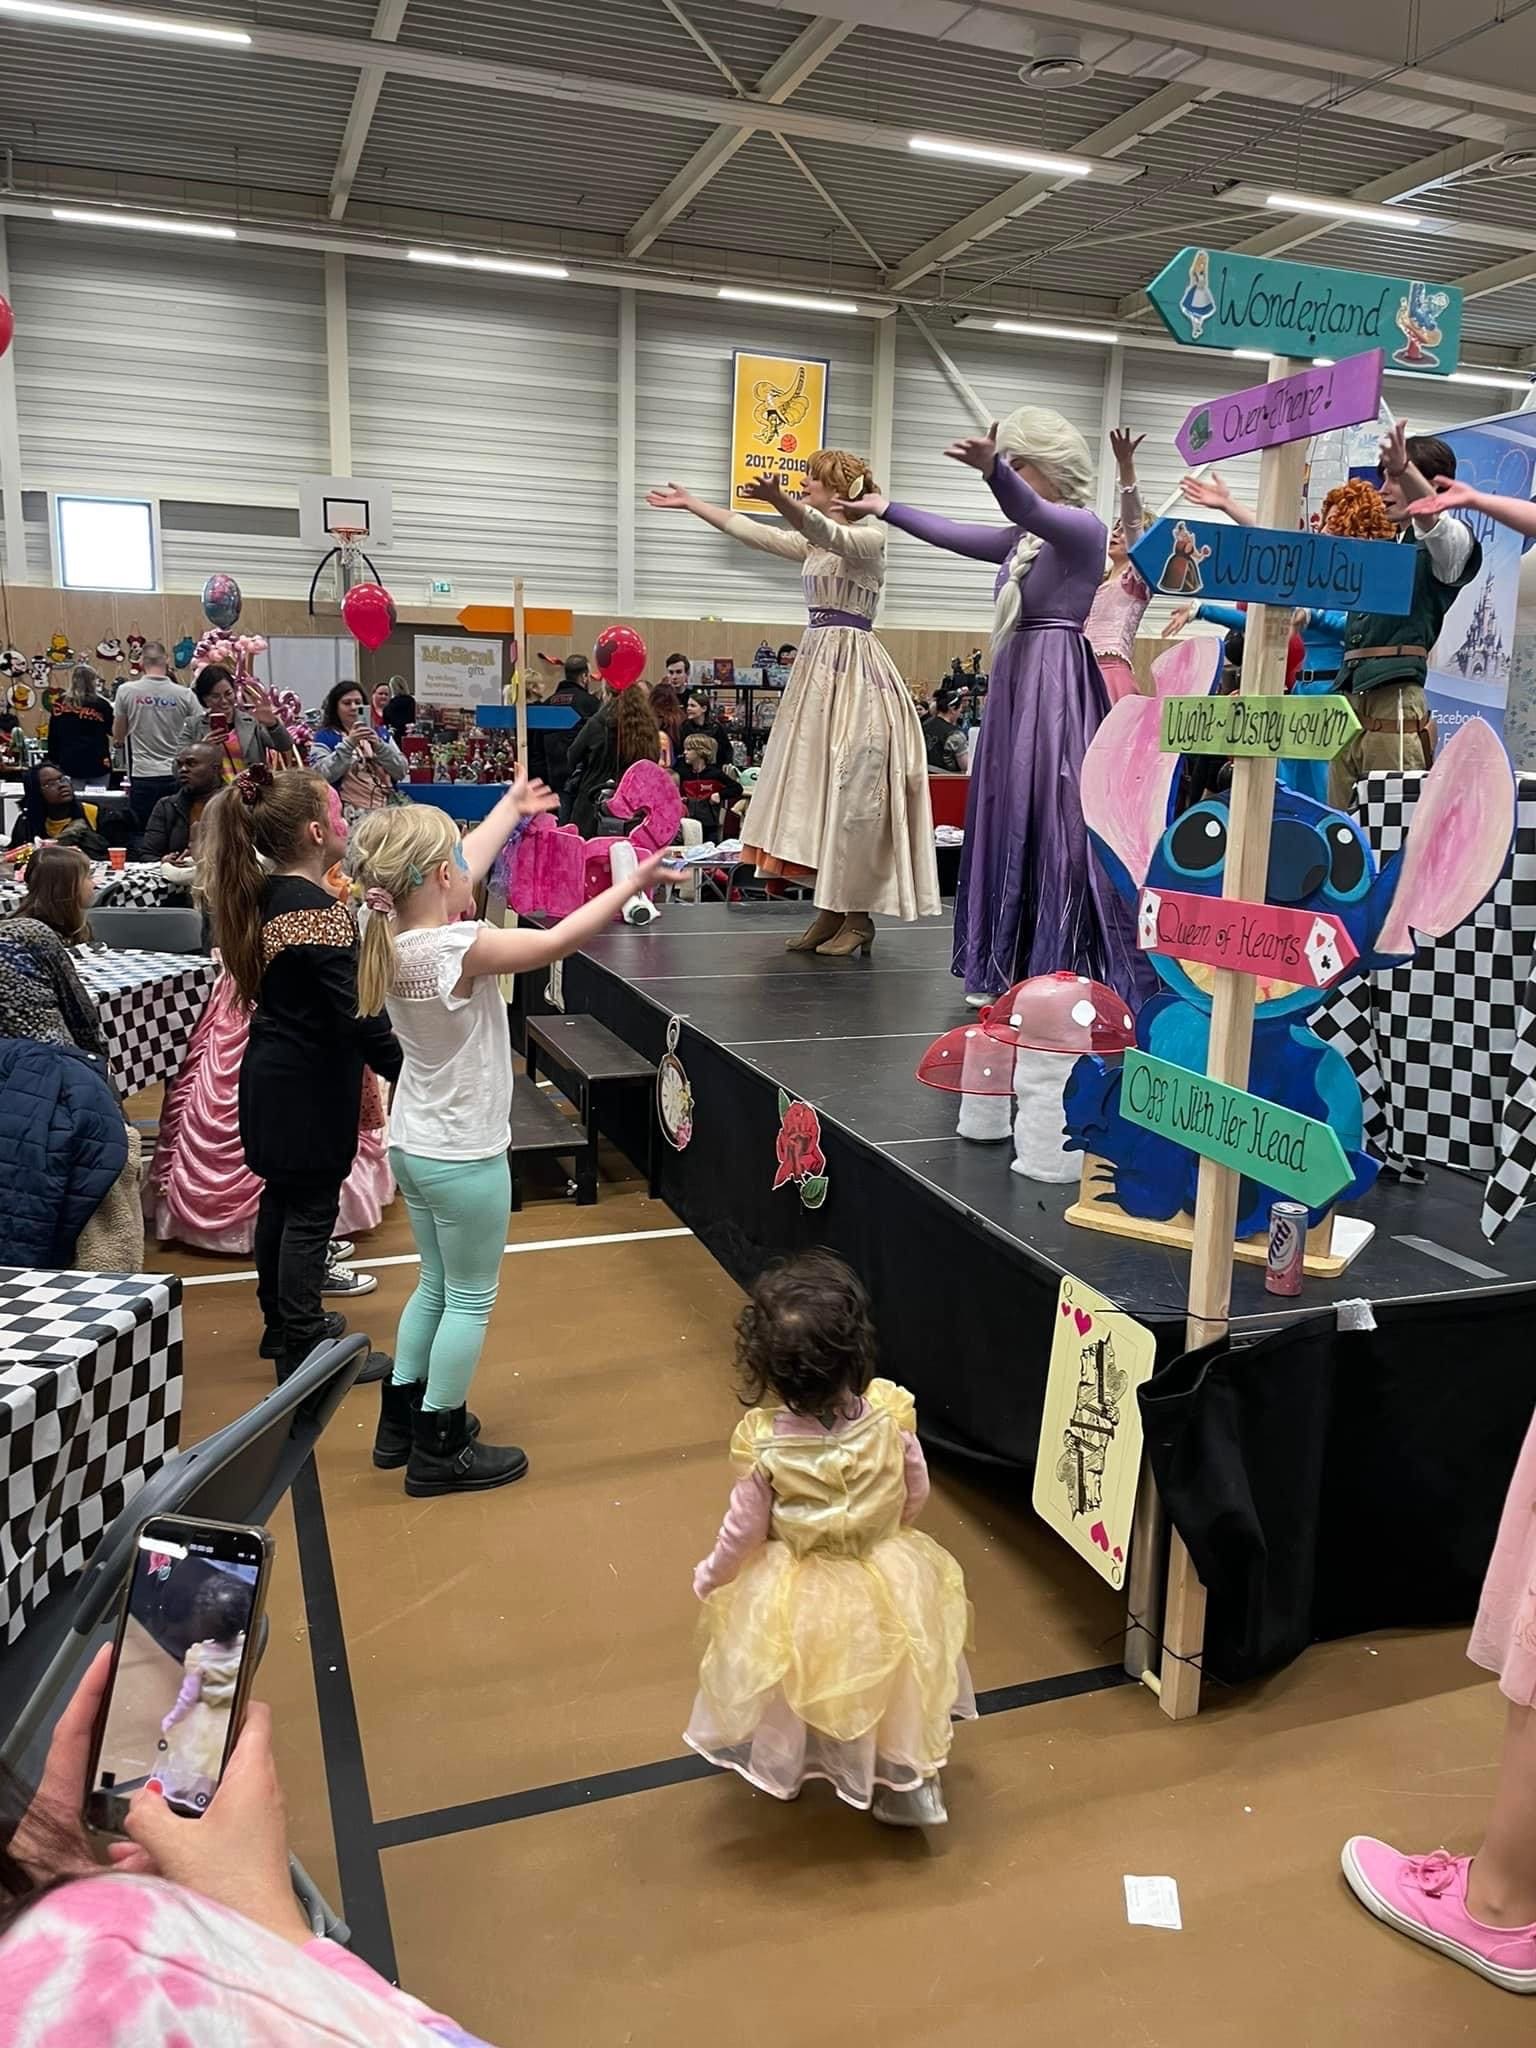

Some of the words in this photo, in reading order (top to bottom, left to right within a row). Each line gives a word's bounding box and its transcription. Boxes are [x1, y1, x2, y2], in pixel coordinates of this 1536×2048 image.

[1219, 266, 1390, 337] Wonderland
[1215, 531, 1301, 598] Wrong
[1307, 539, 1364, 605] Way
[1226, 702, 1286, 752] Disney
[1158, 903, 1211, 946] Queen
[1216, 924, 1237, 955] of
[1238, 916, 1301, 965] Hearts
[1129, 1065, 1169, 1123] Off
[1172, 1078, 1214, 1138] With
[1215, 1096, 1248, 1149] Her
[1248, 1106, 1313, 1173] Head
